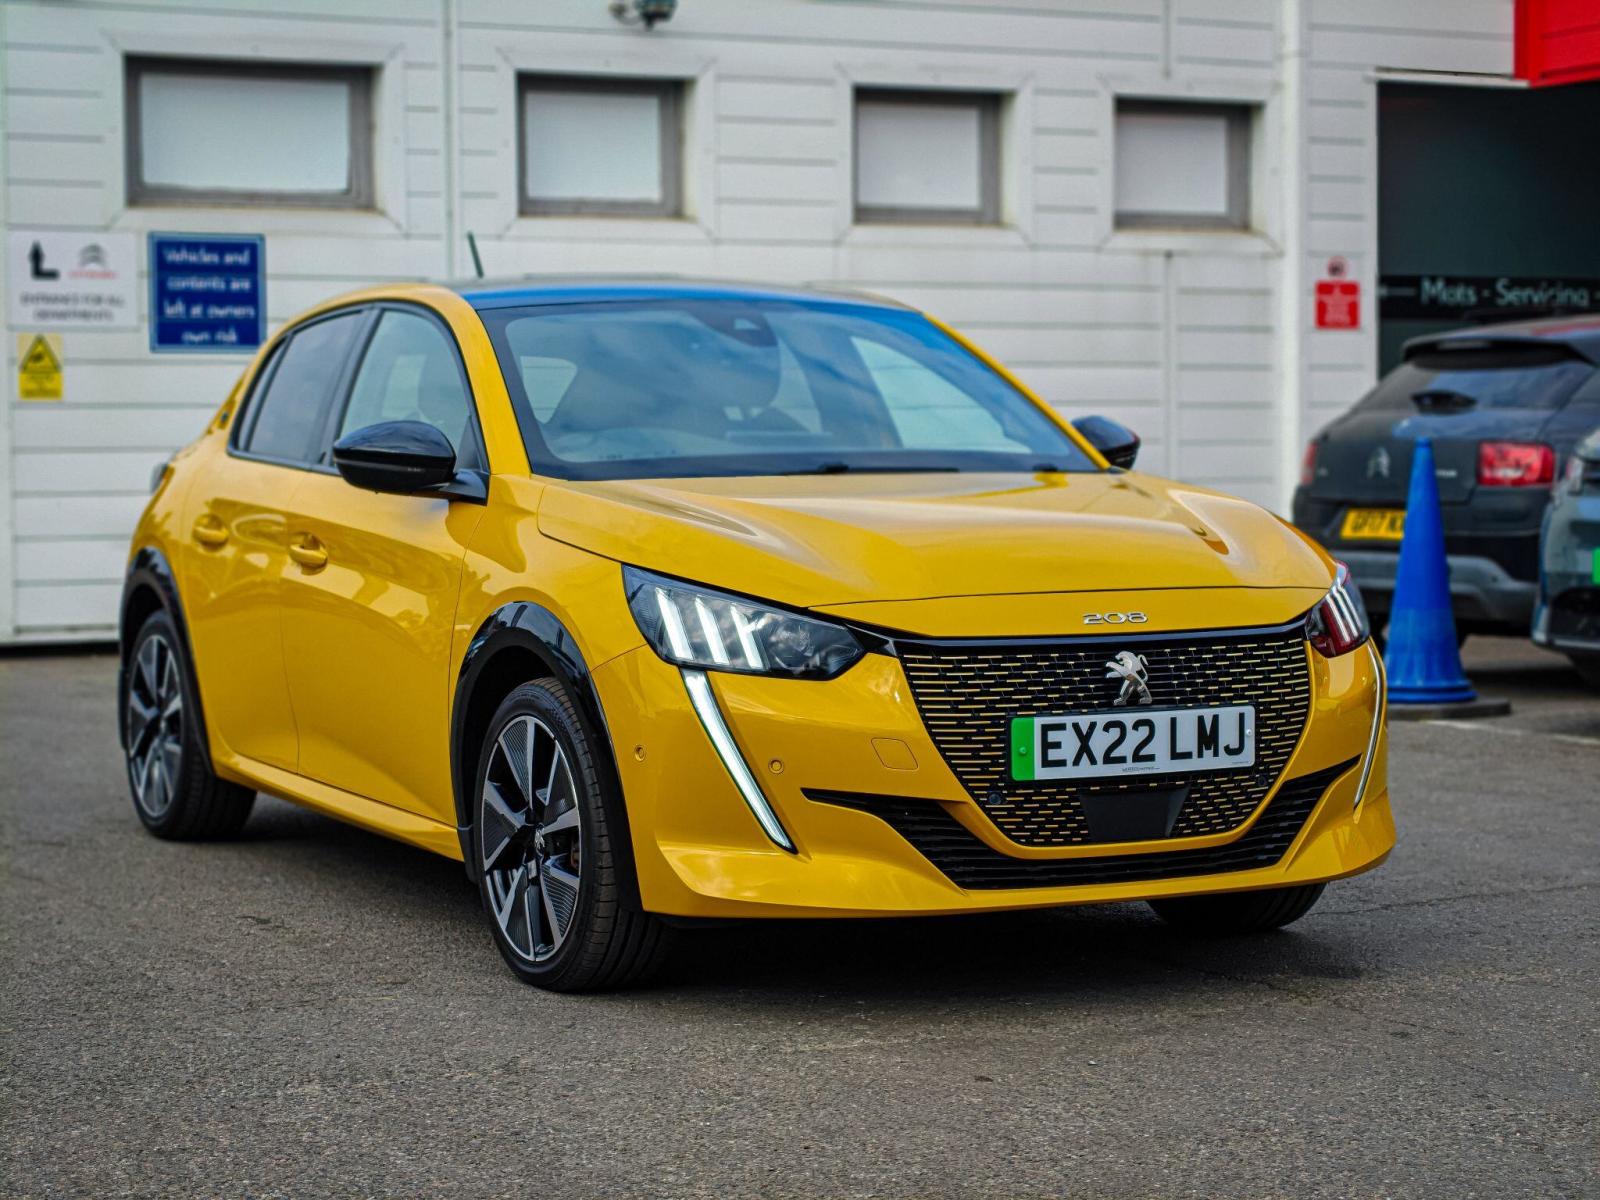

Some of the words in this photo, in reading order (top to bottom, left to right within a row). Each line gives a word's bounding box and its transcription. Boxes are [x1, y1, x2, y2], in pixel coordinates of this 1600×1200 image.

[164, 247, 218, 264] Vehicles
[225, 248, 250, 264] and
[168, 277, 225, 291] contents
[230, 278, 251, 292] are
[164, 299, 186, 317] left
[190, 303, 203, 318] at
[181, 330, 211, 343] own
[215, 327, 238, 343] risk
[1083, 611, 1149, 625] 208
[1041, 718, 1156, 768] EX22
[1169, 711, 1245, 761] LMJ
